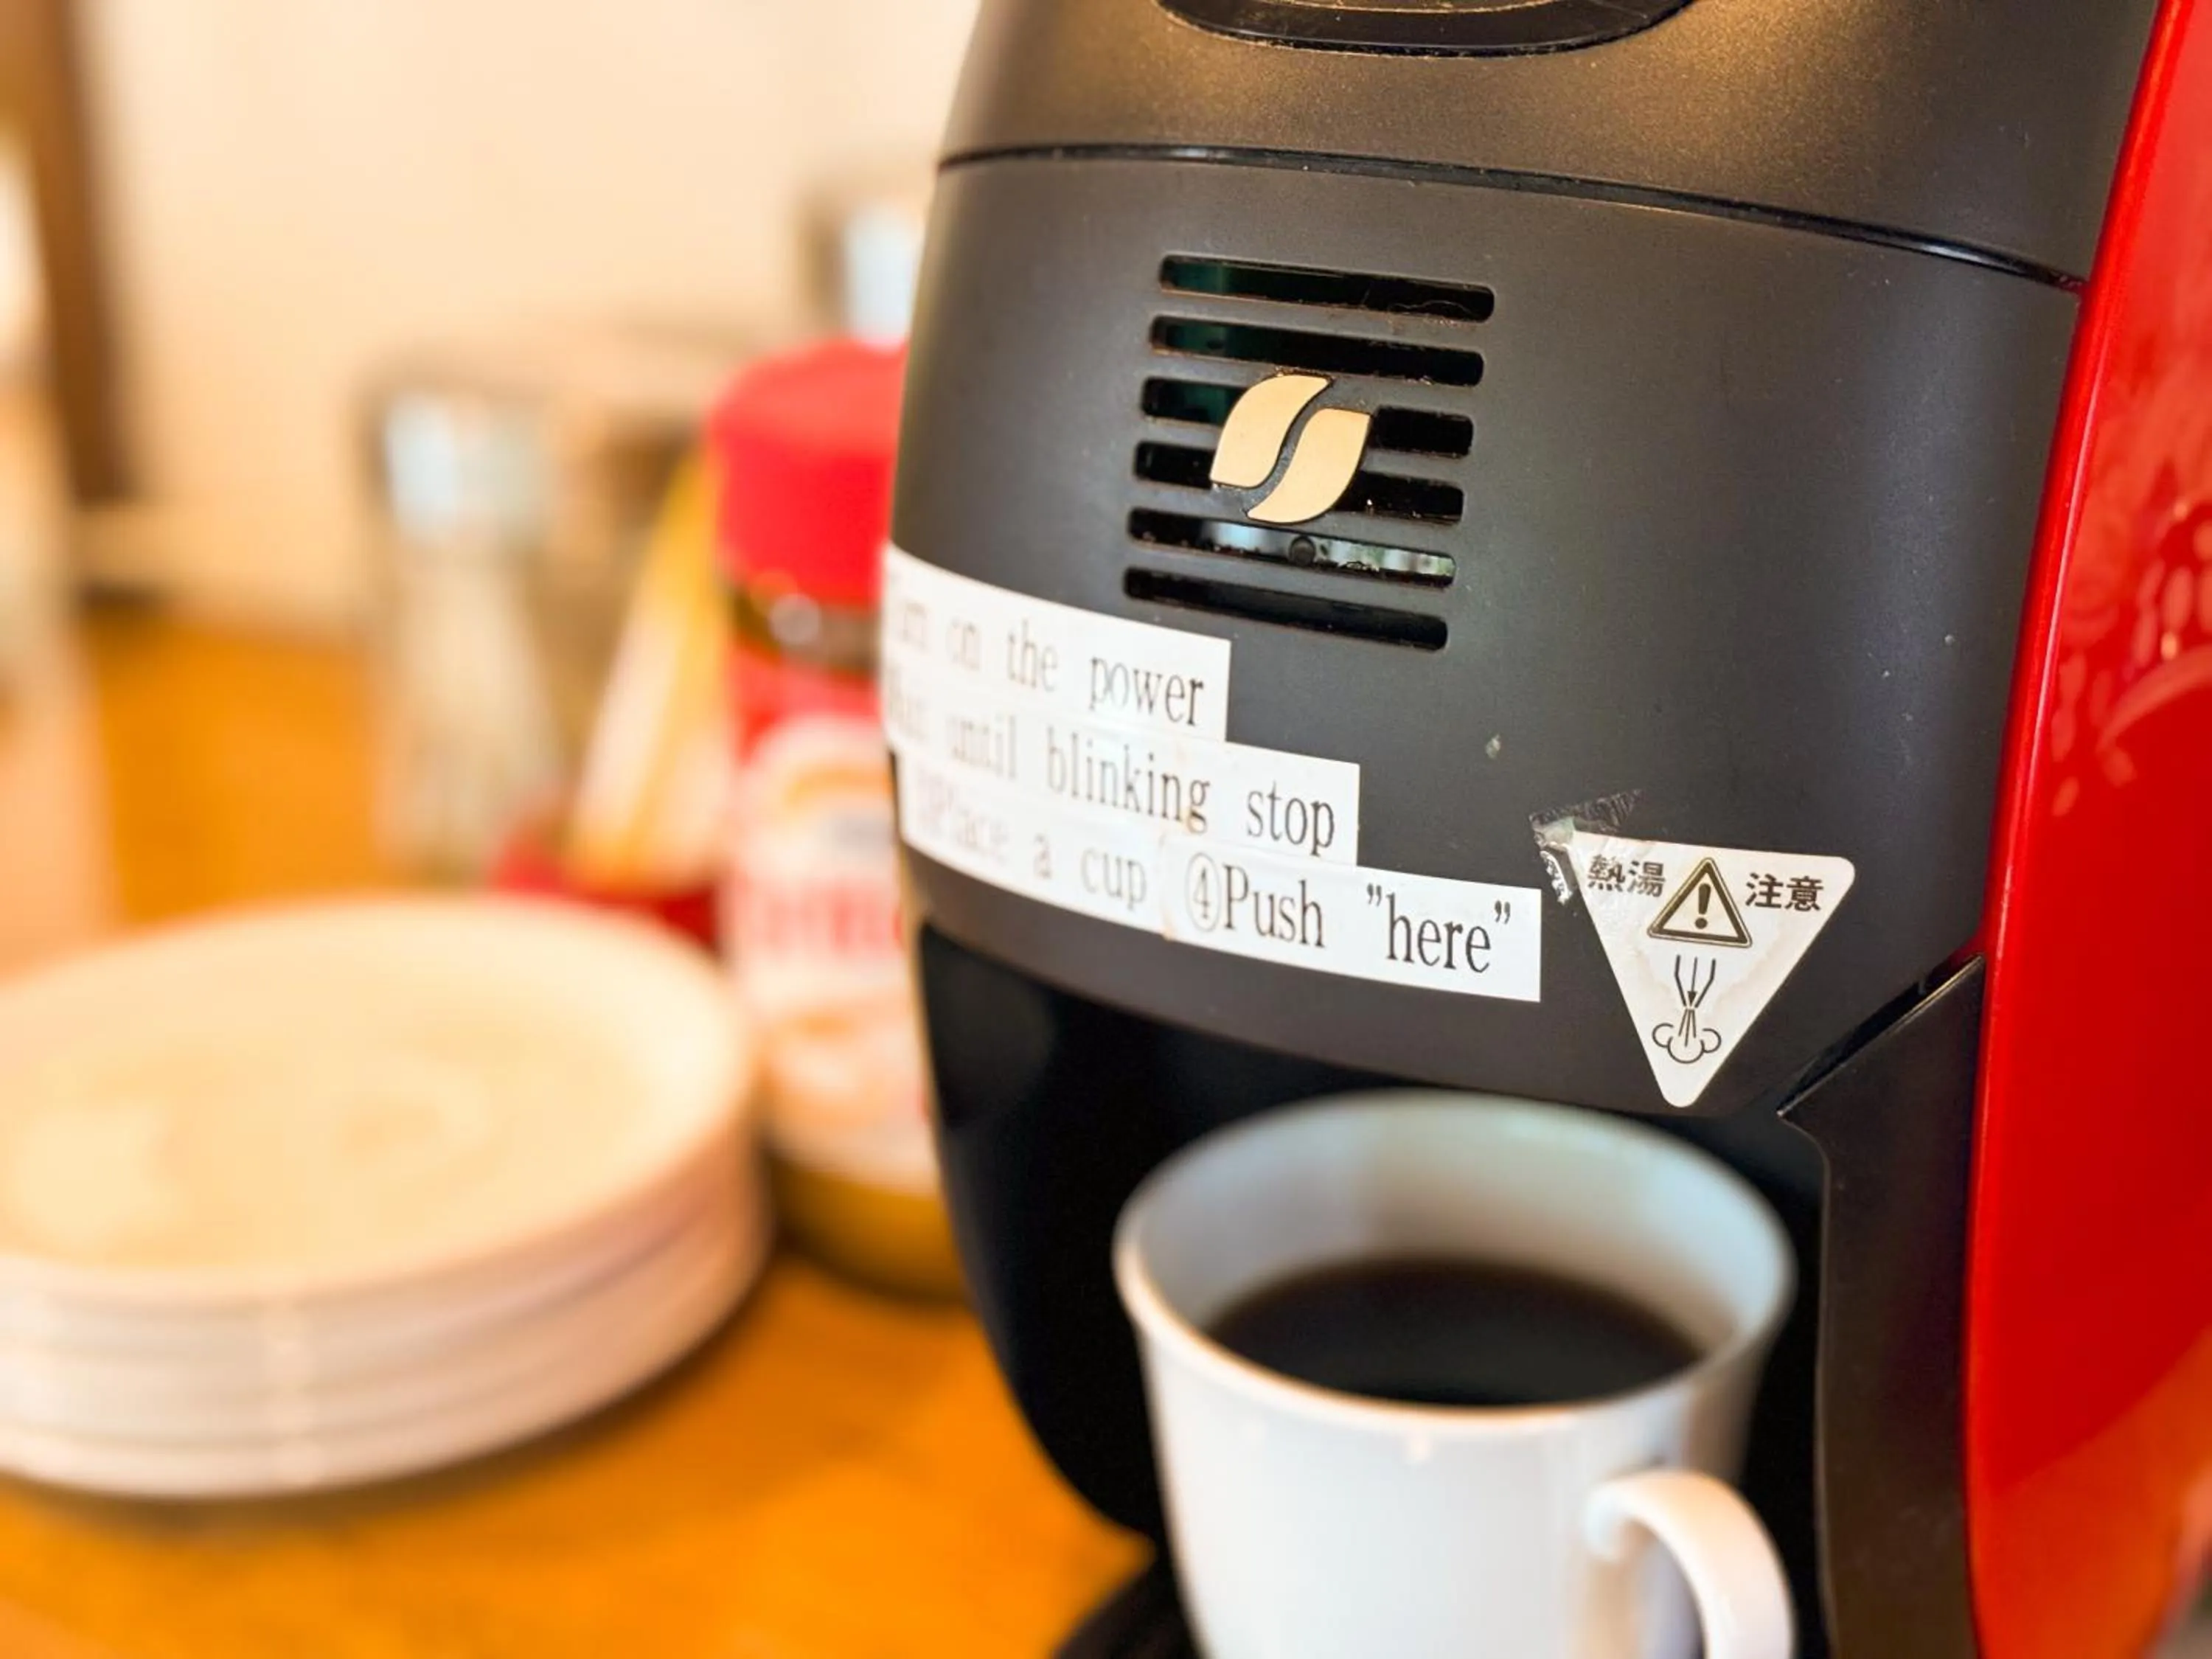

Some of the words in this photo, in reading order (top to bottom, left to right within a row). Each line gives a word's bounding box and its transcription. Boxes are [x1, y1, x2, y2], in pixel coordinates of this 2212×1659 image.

[1006, 618, 1060, 692] the
[1090, 656, 1205, 726] power
[1046, 725, 1211, 834] blinking
[1246, 781, 1336, 858] stop
[1034, 833, 1052, 880] a
[1080, 846, 1147, 911] cup
[1587, 853, 1666, 898] 熱湯
[1745, 871, 1825, 913] 注意
